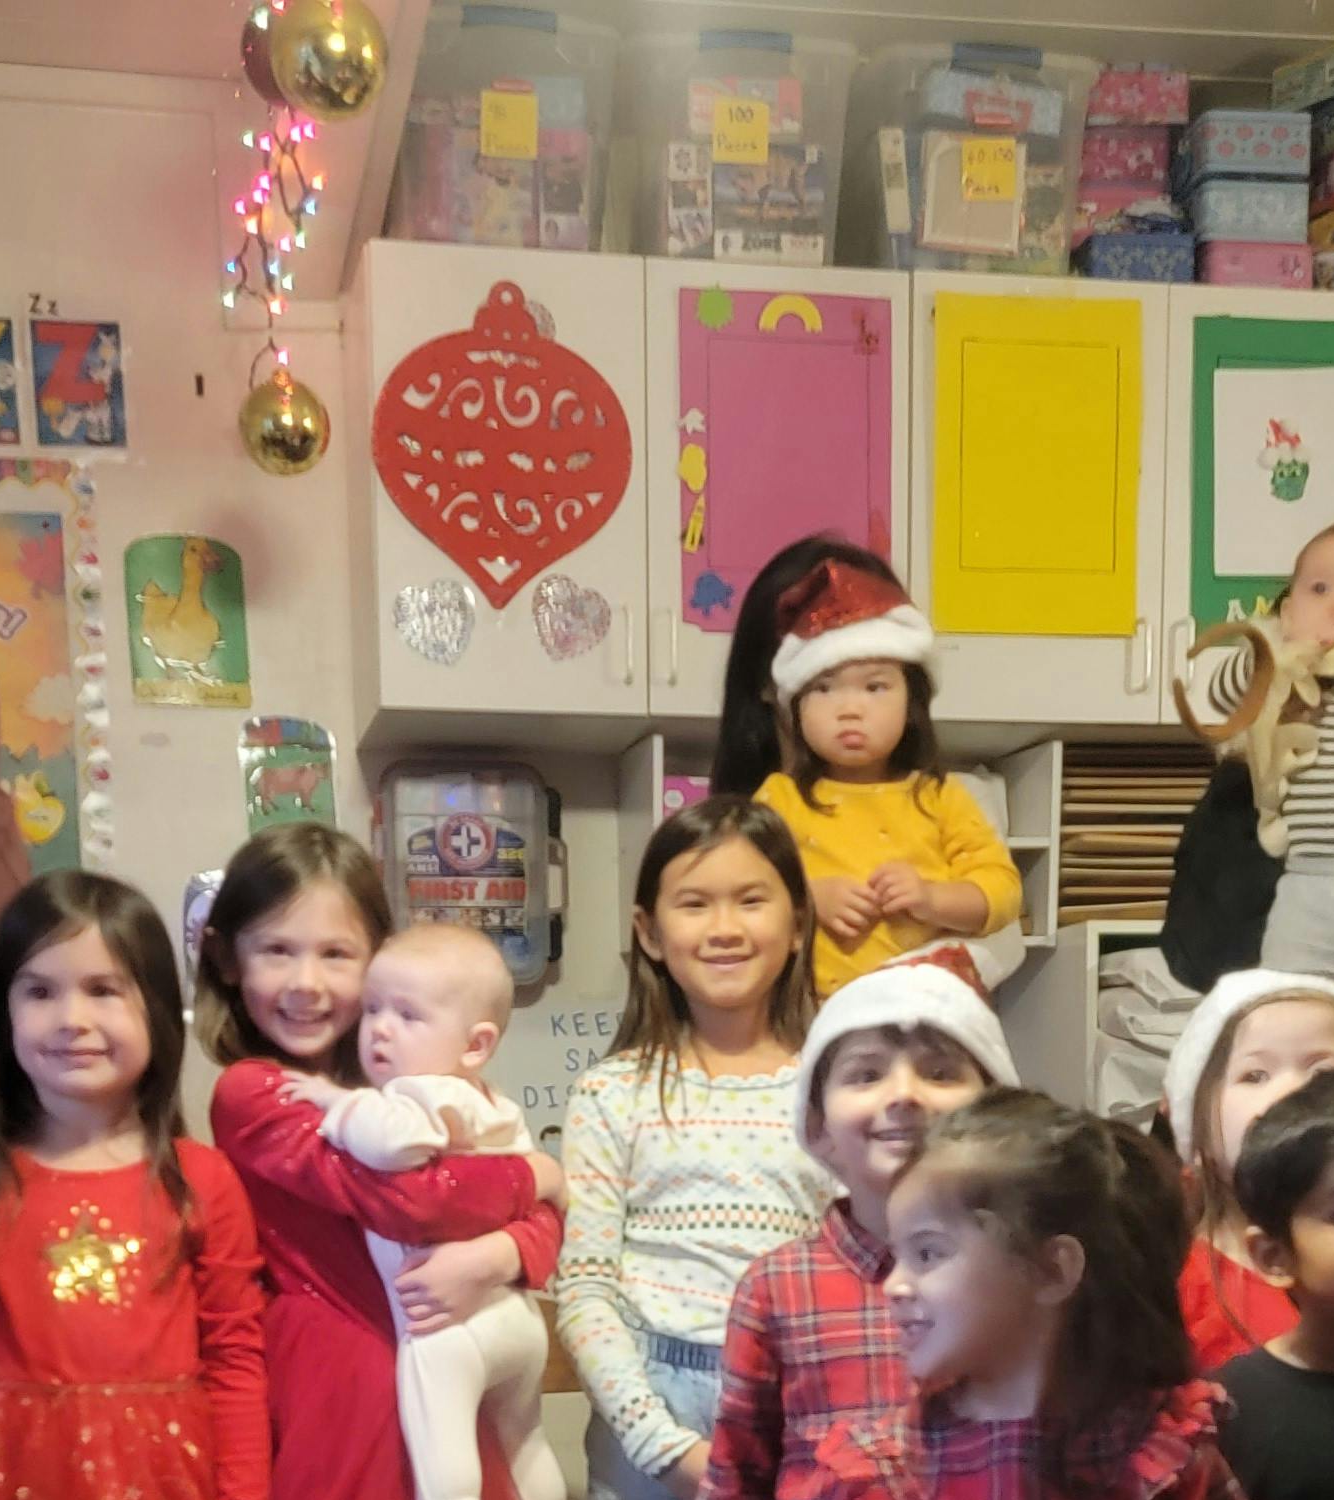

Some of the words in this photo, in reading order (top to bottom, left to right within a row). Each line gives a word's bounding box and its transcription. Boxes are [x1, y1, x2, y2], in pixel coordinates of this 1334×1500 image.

[729, 105, 754, 124] 100
[27, 292, 59, 316] Zz
[409, 879, 479, 901] FIRST
[486, 878, 527, 901] AID
